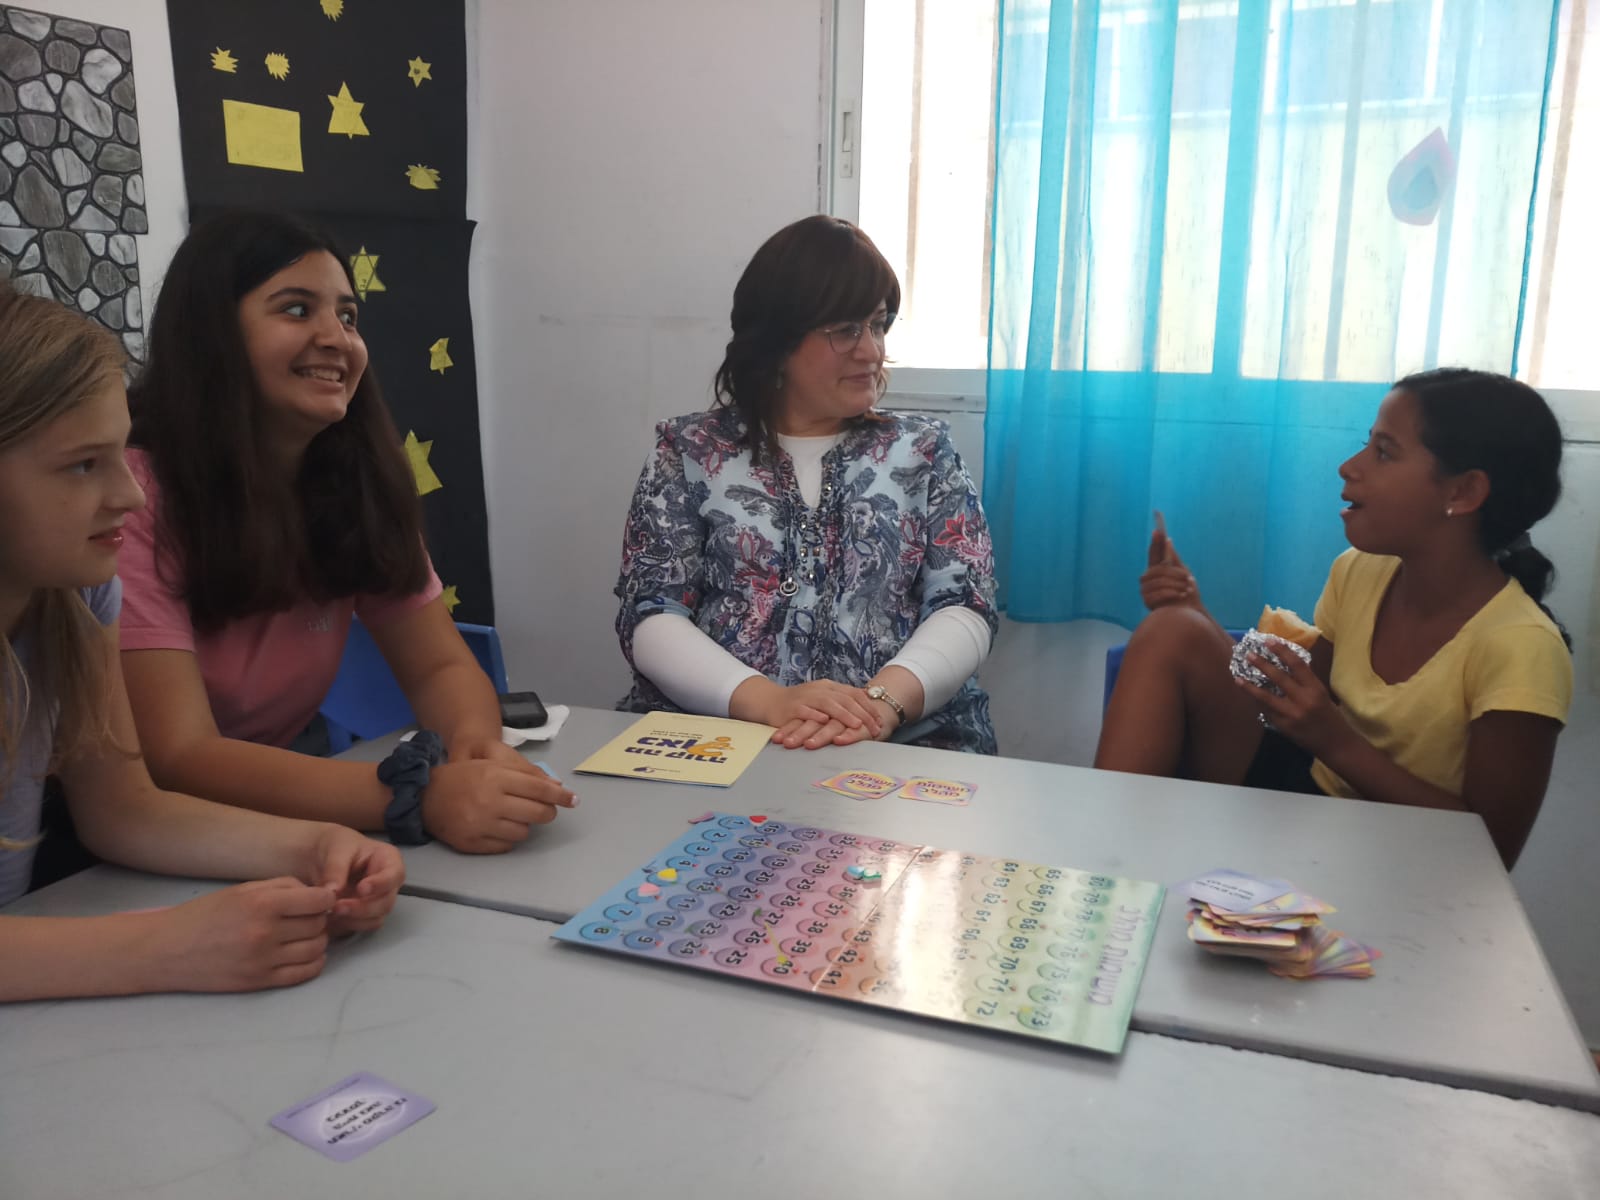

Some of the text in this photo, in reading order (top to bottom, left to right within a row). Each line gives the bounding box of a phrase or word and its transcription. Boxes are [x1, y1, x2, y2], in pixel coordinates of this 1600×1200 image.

[624, 746, 728, 764] מה קורה
[763, 825, 780, 833] 16
[802, 830, 817, 839] 17
[839, 835, 857, 846] 32
[786, 843, 803, 853] 18
[878, 842, 896, 852] 33
[733, 850, 749, 860] 14
[825, 849, 844, 860] 31
[771, 858, 788, 867] 19
[1002, 862, 1019, 873] 64
[714, 866, 732, 876] 13
[811, 863, 830, 875] 30
[1045, 869, 1062, 879] 65
[755, 871, 775, 883] 20
[992, 877, 1011, 888] 63
[696, 880, 715, 892] 12
[796, 878, 816, 890] 29
[1037, 884, 1055, 895] 66
[738, 887, 758, 899] 21
[839, 886, 857, 898] 36
[983, 892, 1001, 904] 62
[1082, 892, 1100, 903] 79
[677, 897, 697, 909] 11
[780, 894, 801, 907] 28
[1028, 900, 1047, 913] 67
[719, 904, 741, 917] 22
[824, 902, 844, 916] 37
[656, 915, 677, 927] 10
[764, 912, 784, 926] 27
[972, 909, 992, 922] 61
[699, 922, 722, 935] 23
[807, 920, 829, 934] 38
[1019, 918, 1038, 930] 68
[637, 935, 654, 943] 9
[744, 930, 767, 944] 26
[853, 929, 873, 942] 43
[961, 928, 981, 940] 60
[679, 941, 702, 955] 24
[791, 939, 812, 954] 39
[1009, 936, 1029, 950] 69
[725, 950, 748, 964] 25
[838, 949, 858, 963] 42
[999, 956, 1020, 971] 70
[821, 970, 842, 985] 41
[987, 977, 1009, 993] 71
[976, 1000, 999, 1016] 72
